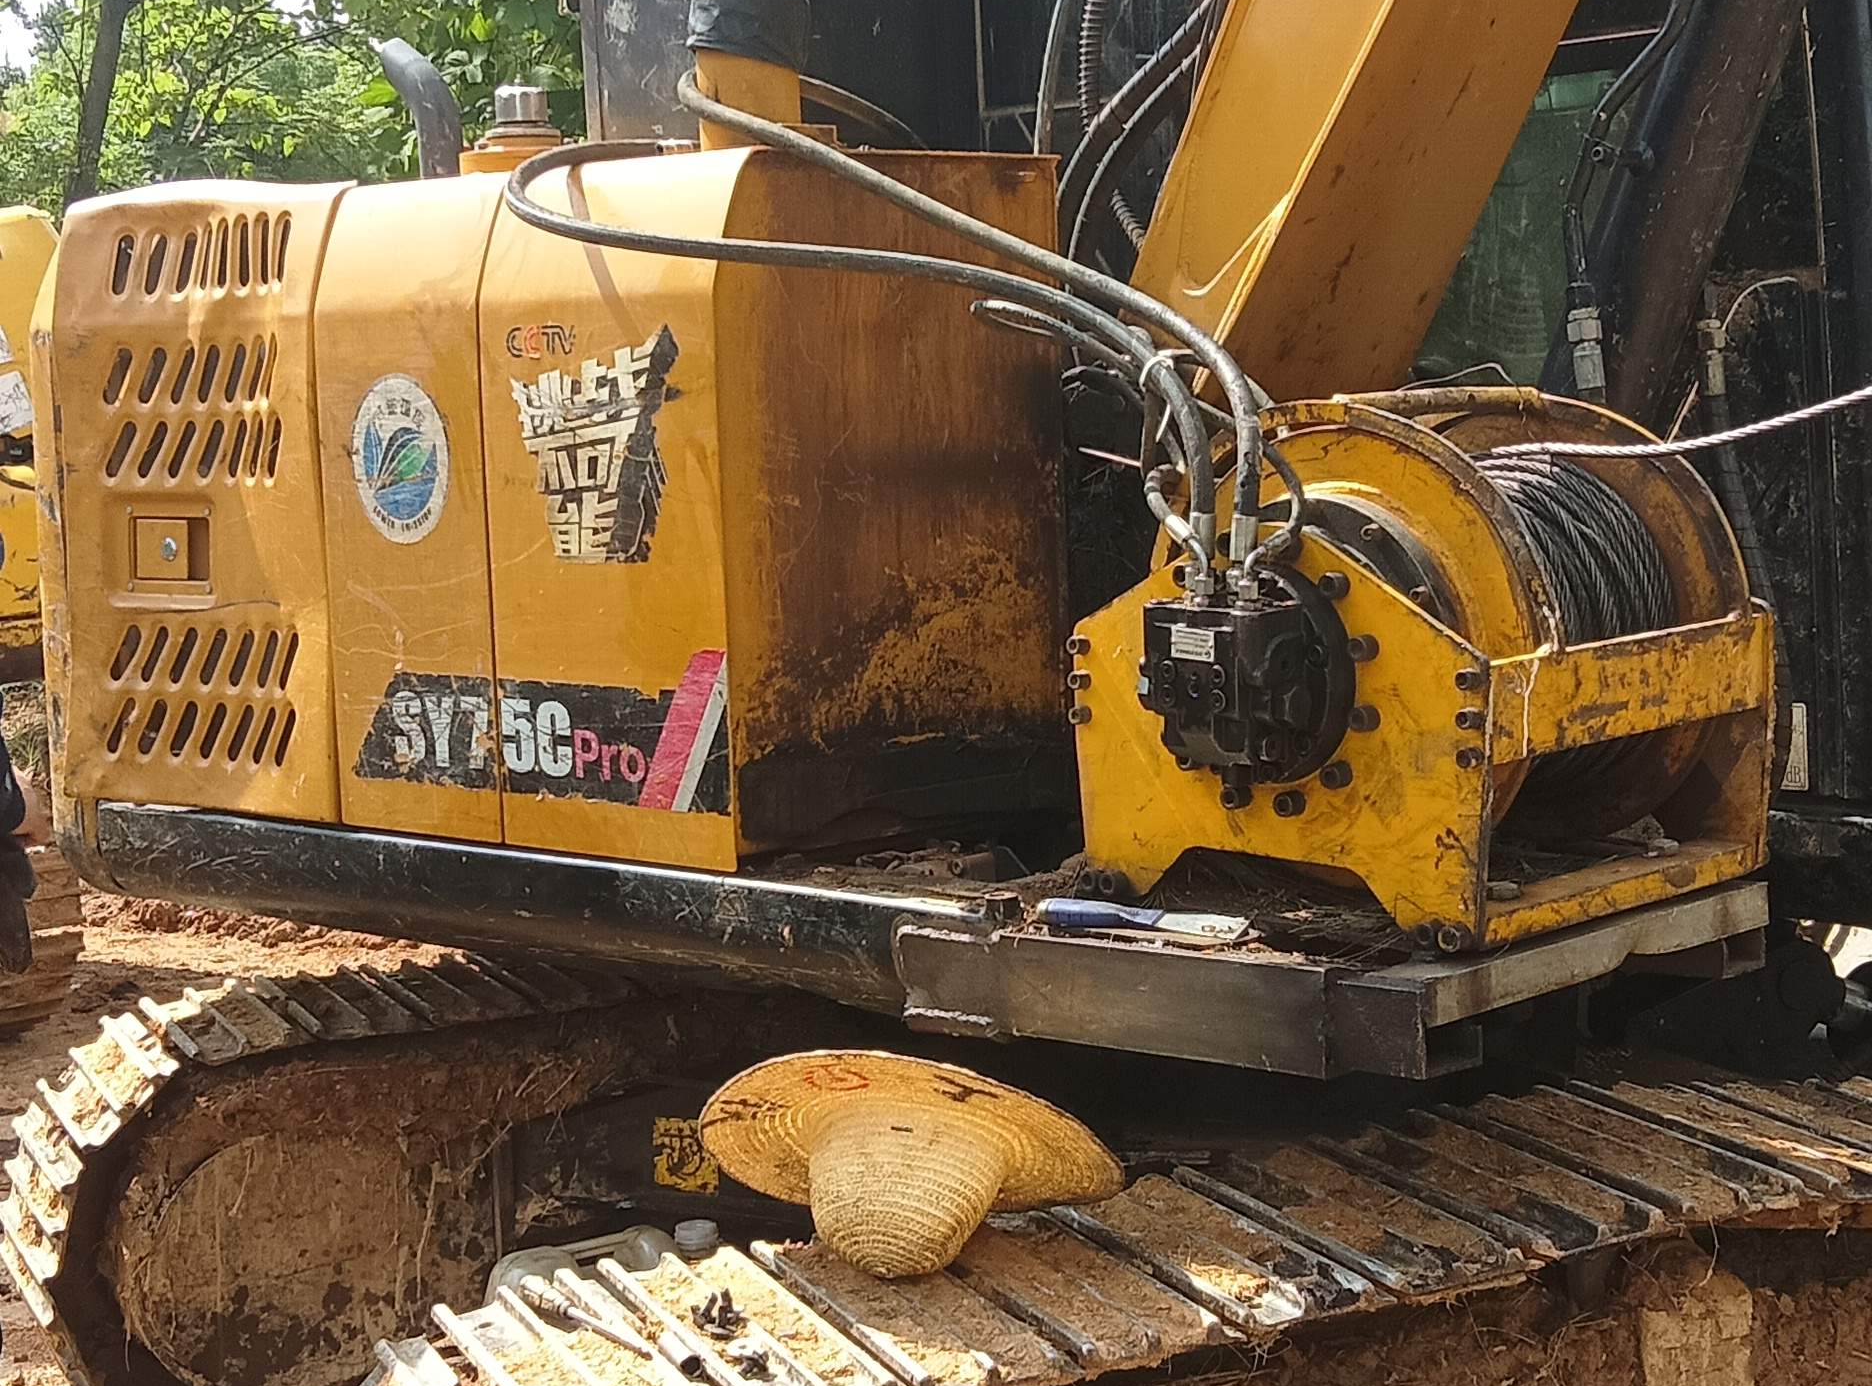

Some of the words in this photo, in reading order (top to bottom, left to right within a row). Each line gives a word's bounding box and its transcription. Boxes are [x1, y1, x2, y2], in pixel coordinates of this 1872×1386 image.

[506, 324, 576, 359] CCTV
[523, 417, 640, 495] 不可
[546, 491, 619, 558] 能
[573, 728, 647, 783] Pro
